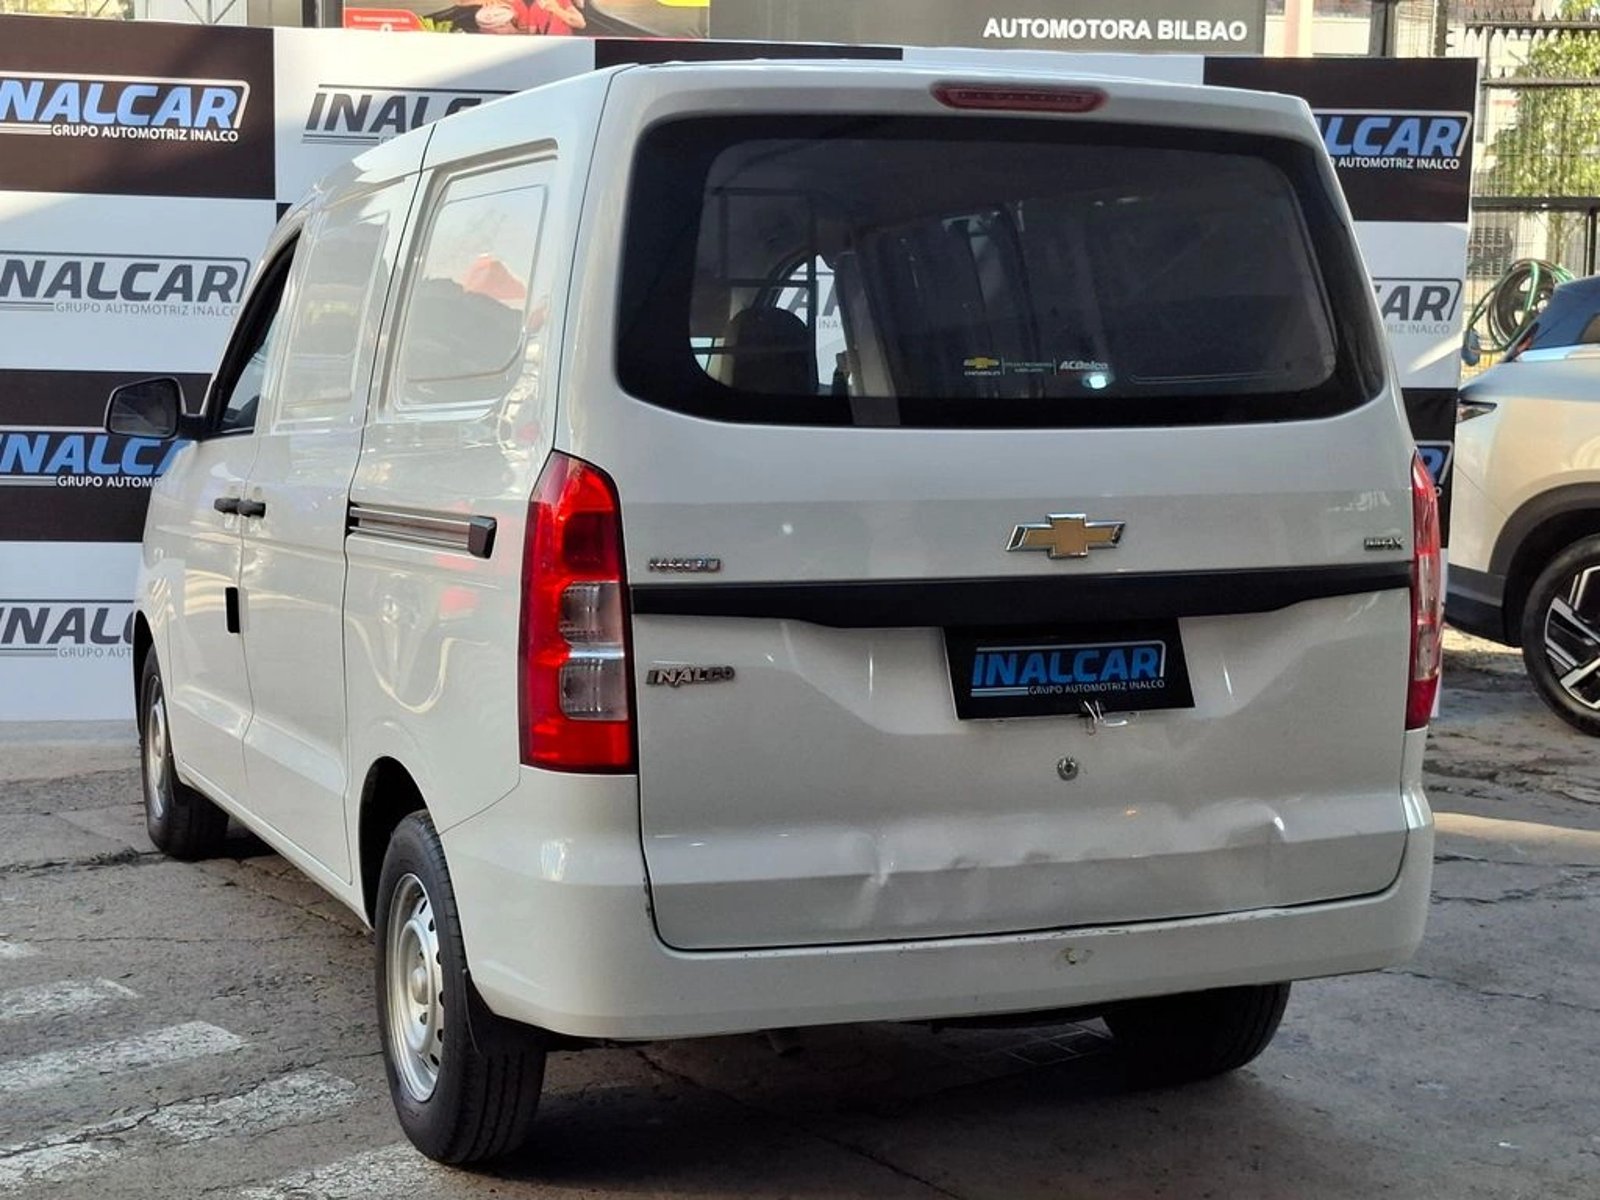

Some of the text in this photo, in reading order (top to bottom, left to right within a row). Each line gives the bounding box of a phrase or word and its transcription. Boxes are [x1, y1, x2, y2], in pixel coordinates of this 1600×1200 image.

[983, 18, 1247, 40] AUTOMOTORA BILBAO
[52, 124, 238, 142] GRUPO AUTOMOTRIZ INALCO
[1316, 117, 1461, 156] LCAR
[1339, 157, 1413, 169] AUTOMOTRIZ
[1417, 158, 1459, 169] INALCO
[56, 303, 100, 313] GRUPO
[105, 305, 188, 316] AUTOMOTRIZ
[1375, 286, 1450, 321] AR
[1408, 324, 1449, 334] INALCO
[57, 475, 103, 487] GRUPO
[59, 647, 104, 658] GRUPO
[972, 647, 1159, 686] INALCAR
[1029, 680, 1165, 695] GRUPO AUTOMOTRIZ INALCO
